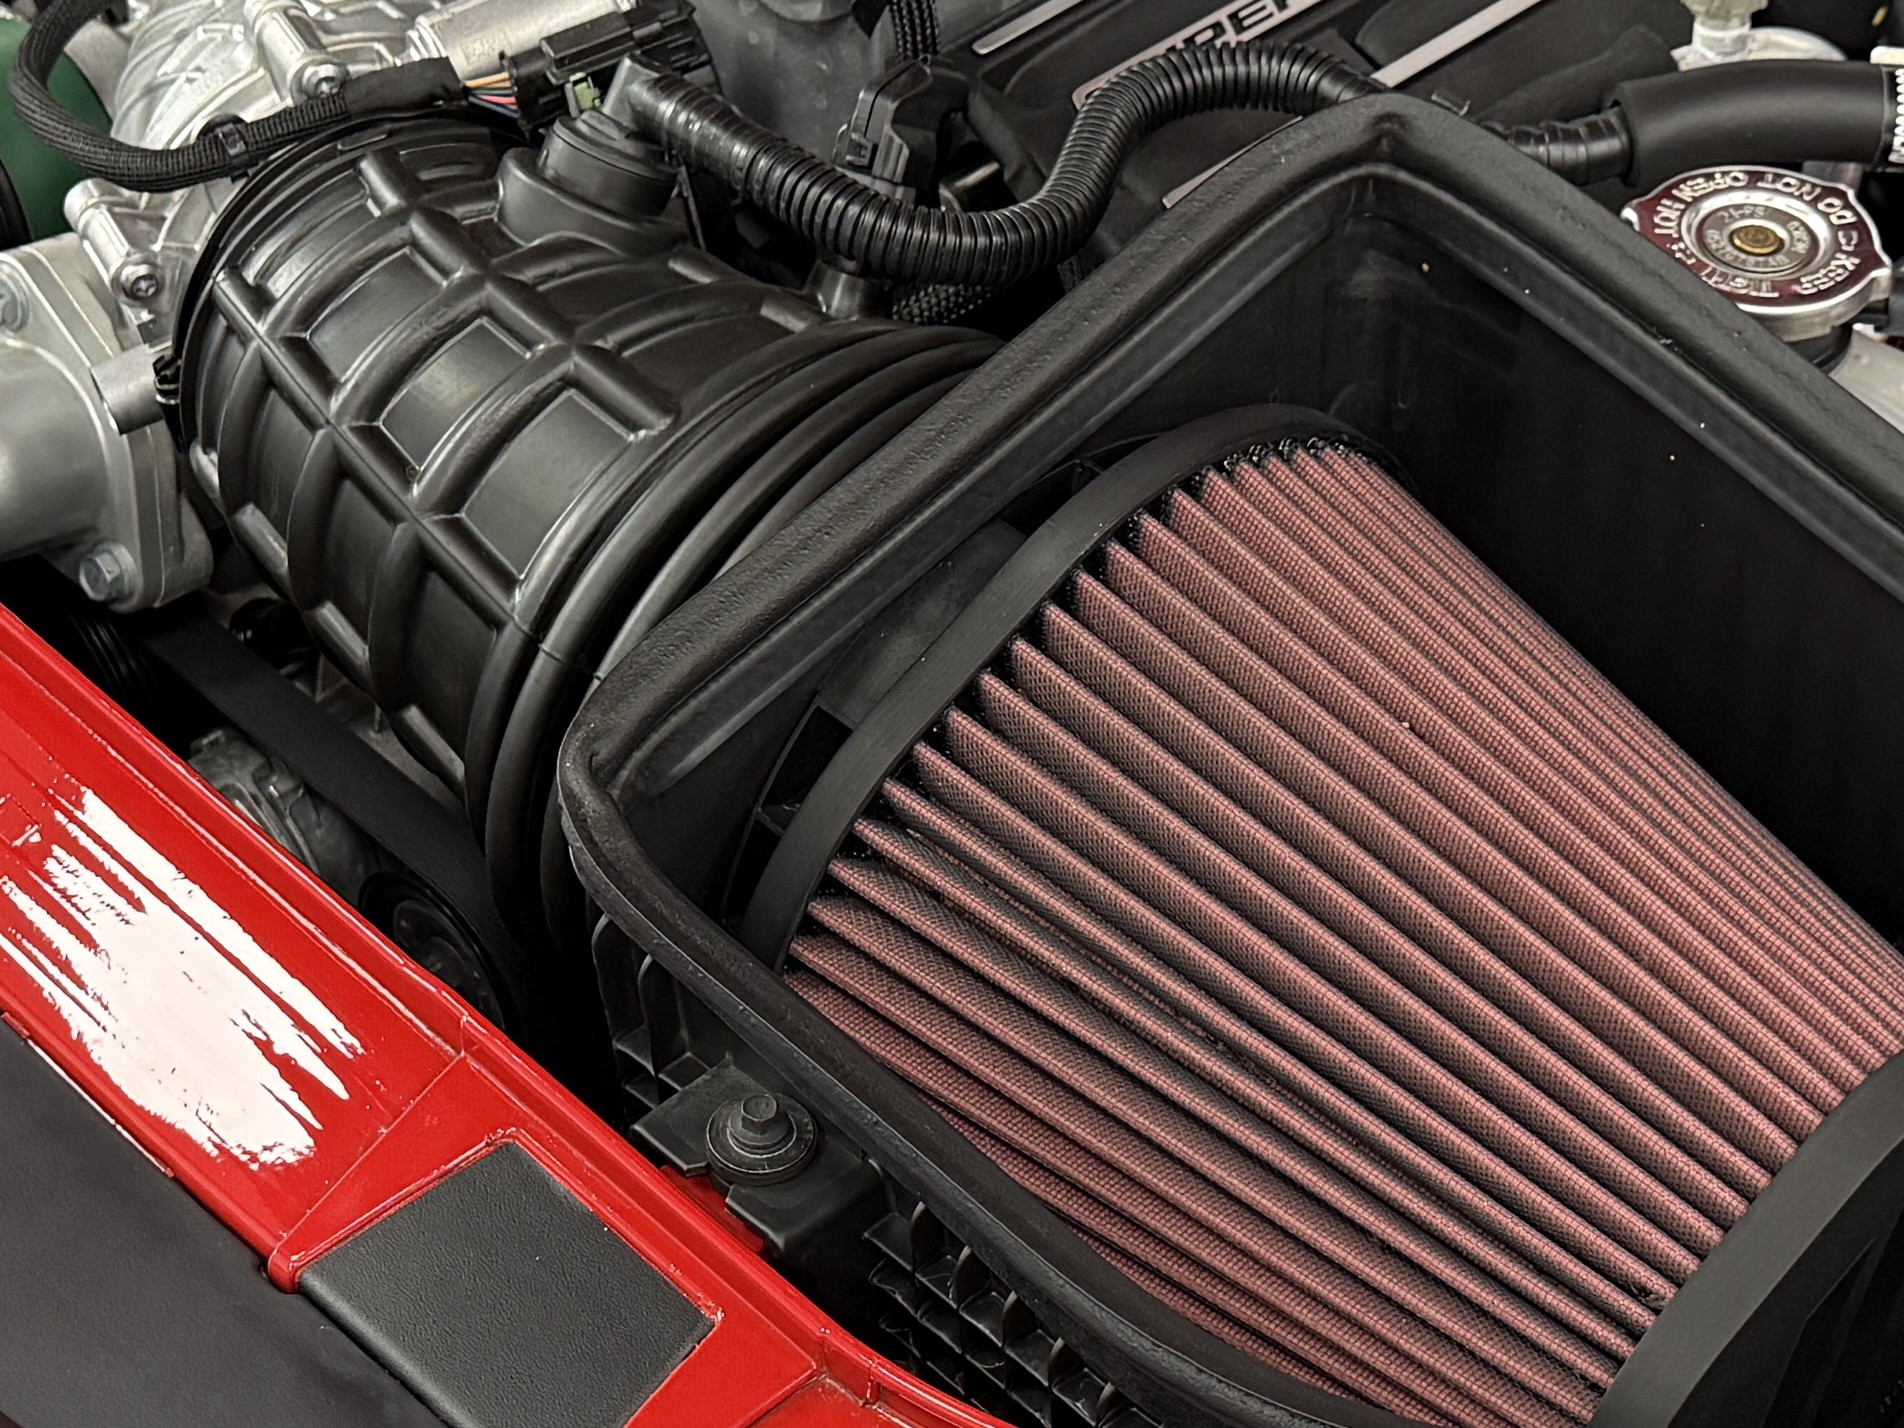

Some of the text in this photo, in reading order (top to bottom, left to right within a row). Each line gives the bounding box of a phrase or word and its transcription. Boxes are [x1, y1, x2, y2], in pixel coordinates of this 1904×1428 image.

[1653, 171, 1859, 238] DO NOT OPEN HOT
